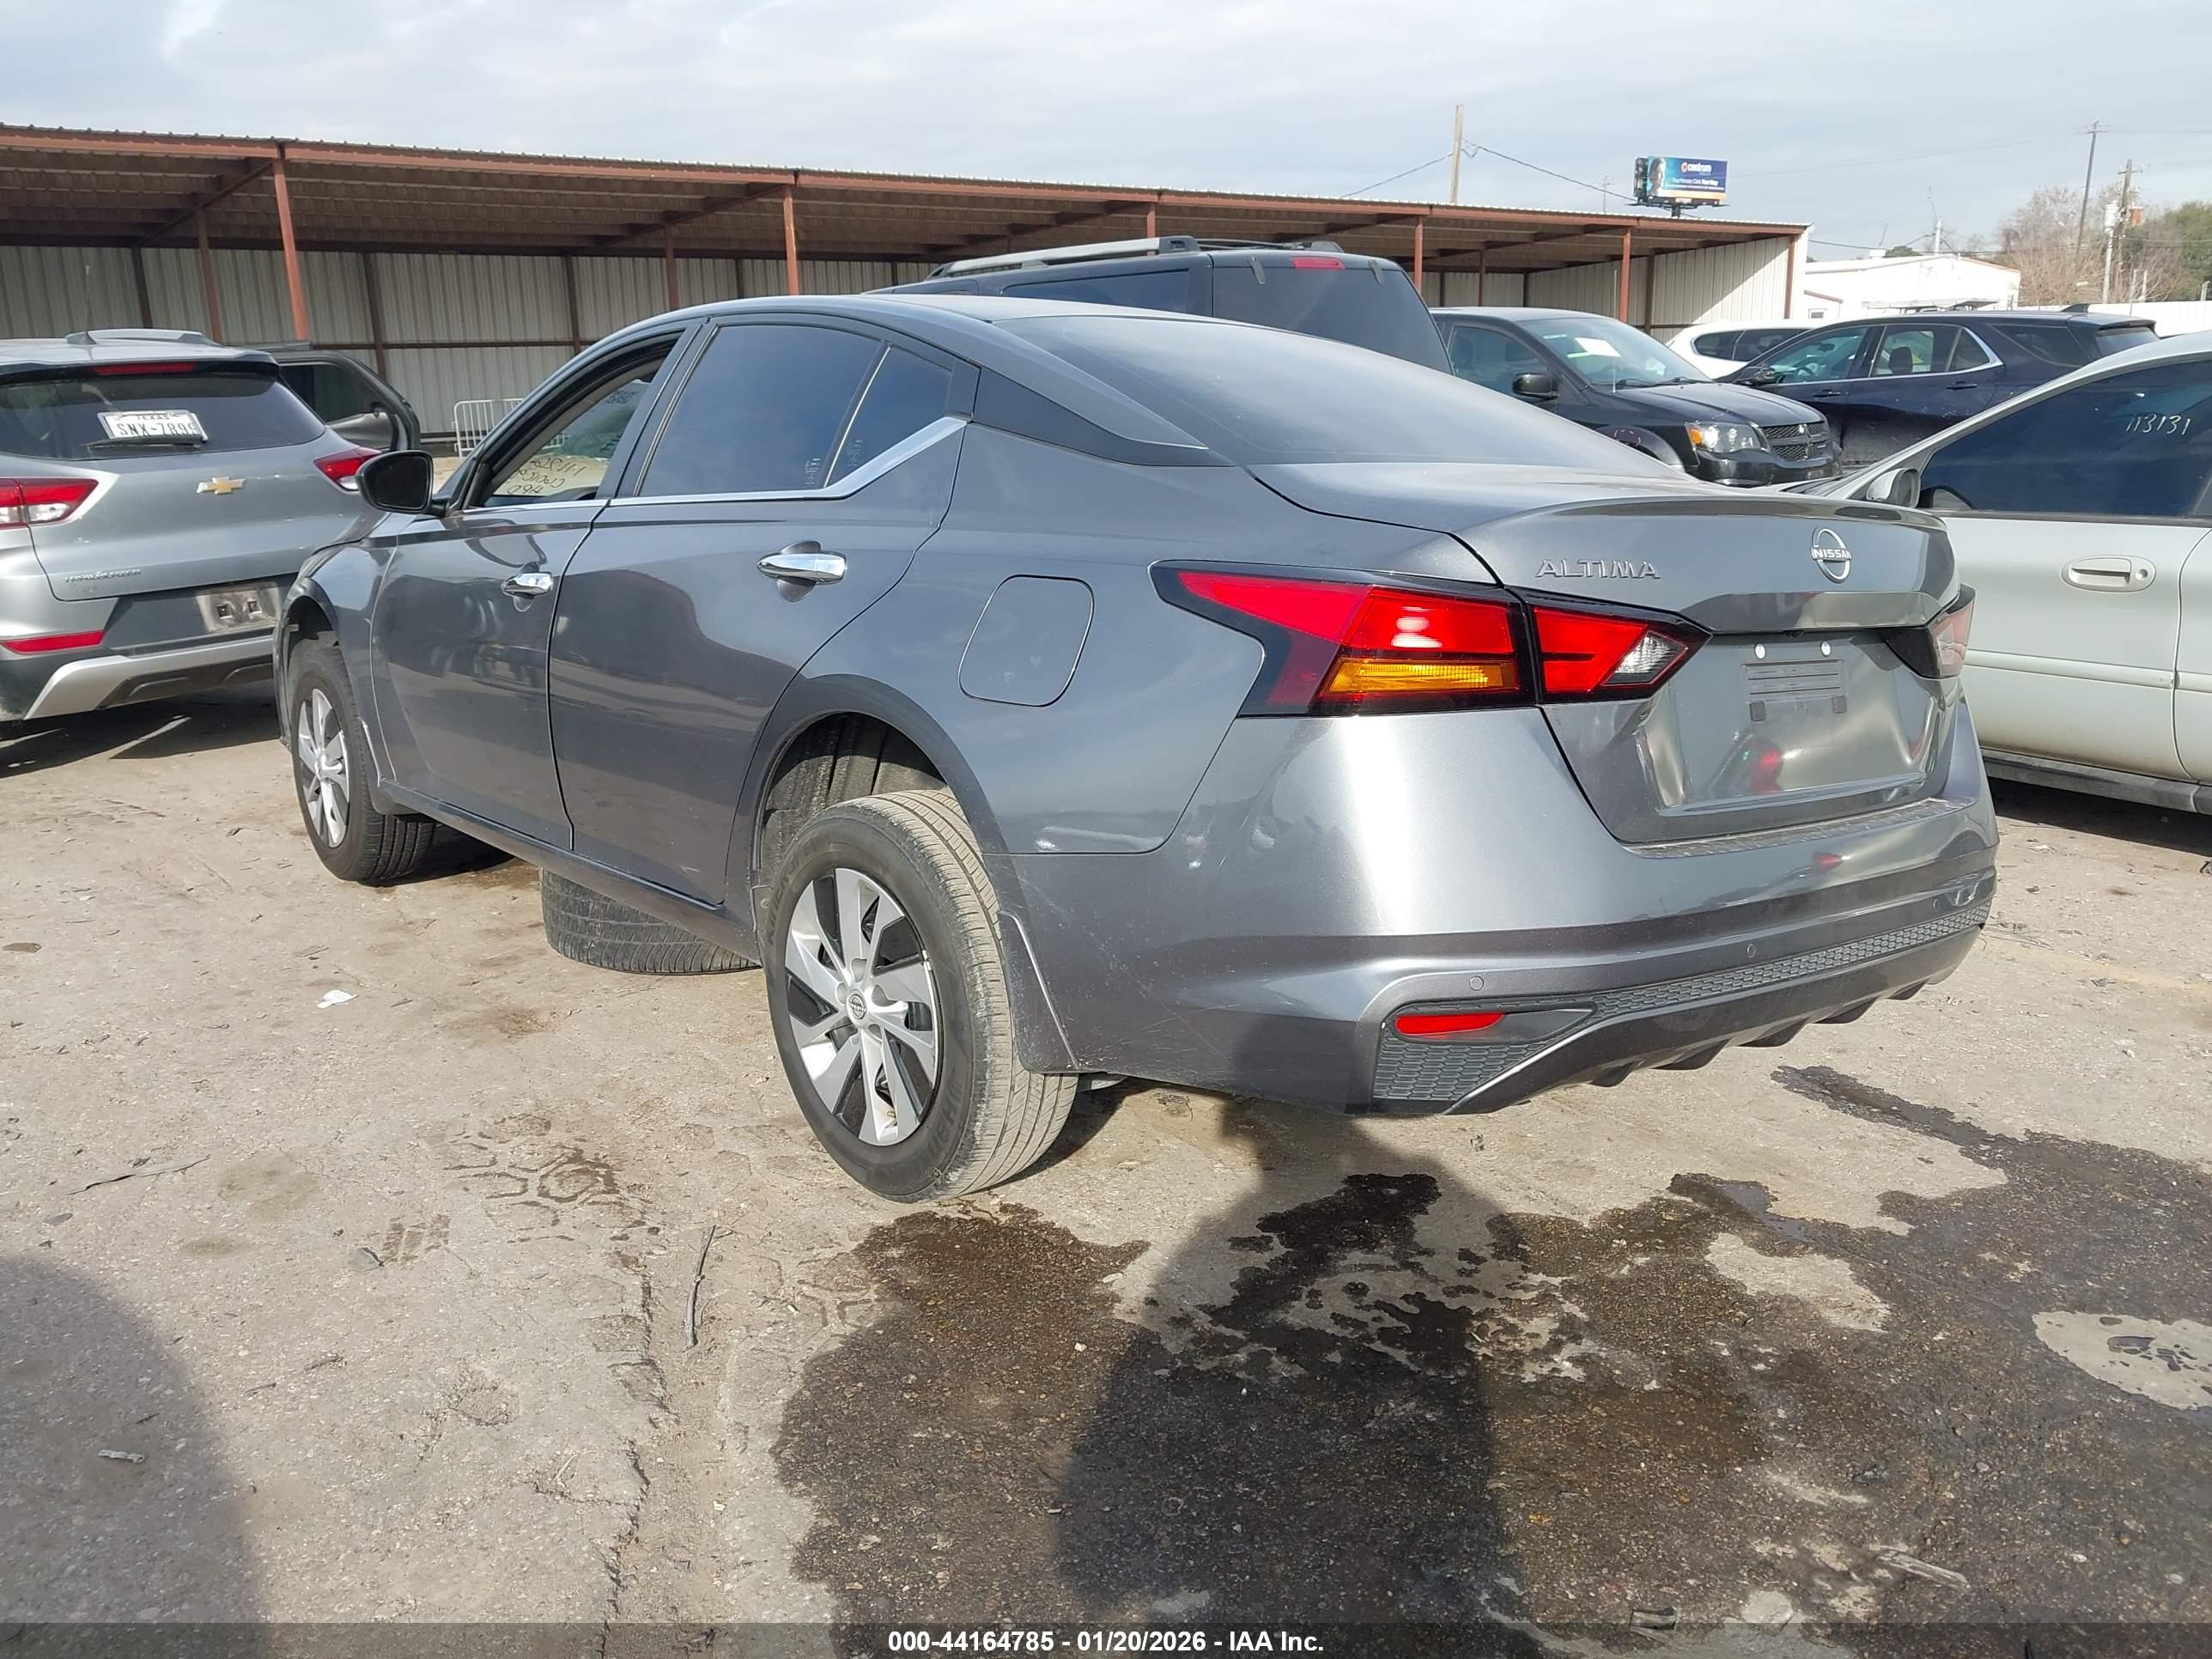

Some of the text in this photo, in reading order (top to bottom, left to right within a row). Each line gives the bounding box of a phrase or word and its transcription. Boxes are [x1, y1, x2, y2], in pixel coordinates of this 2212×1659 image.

[2125, 413, 2191, 435] 113131
[1812, 549, 1852, 560] NISSAN
[1534, 559, 1662, 580] ALTIMA
